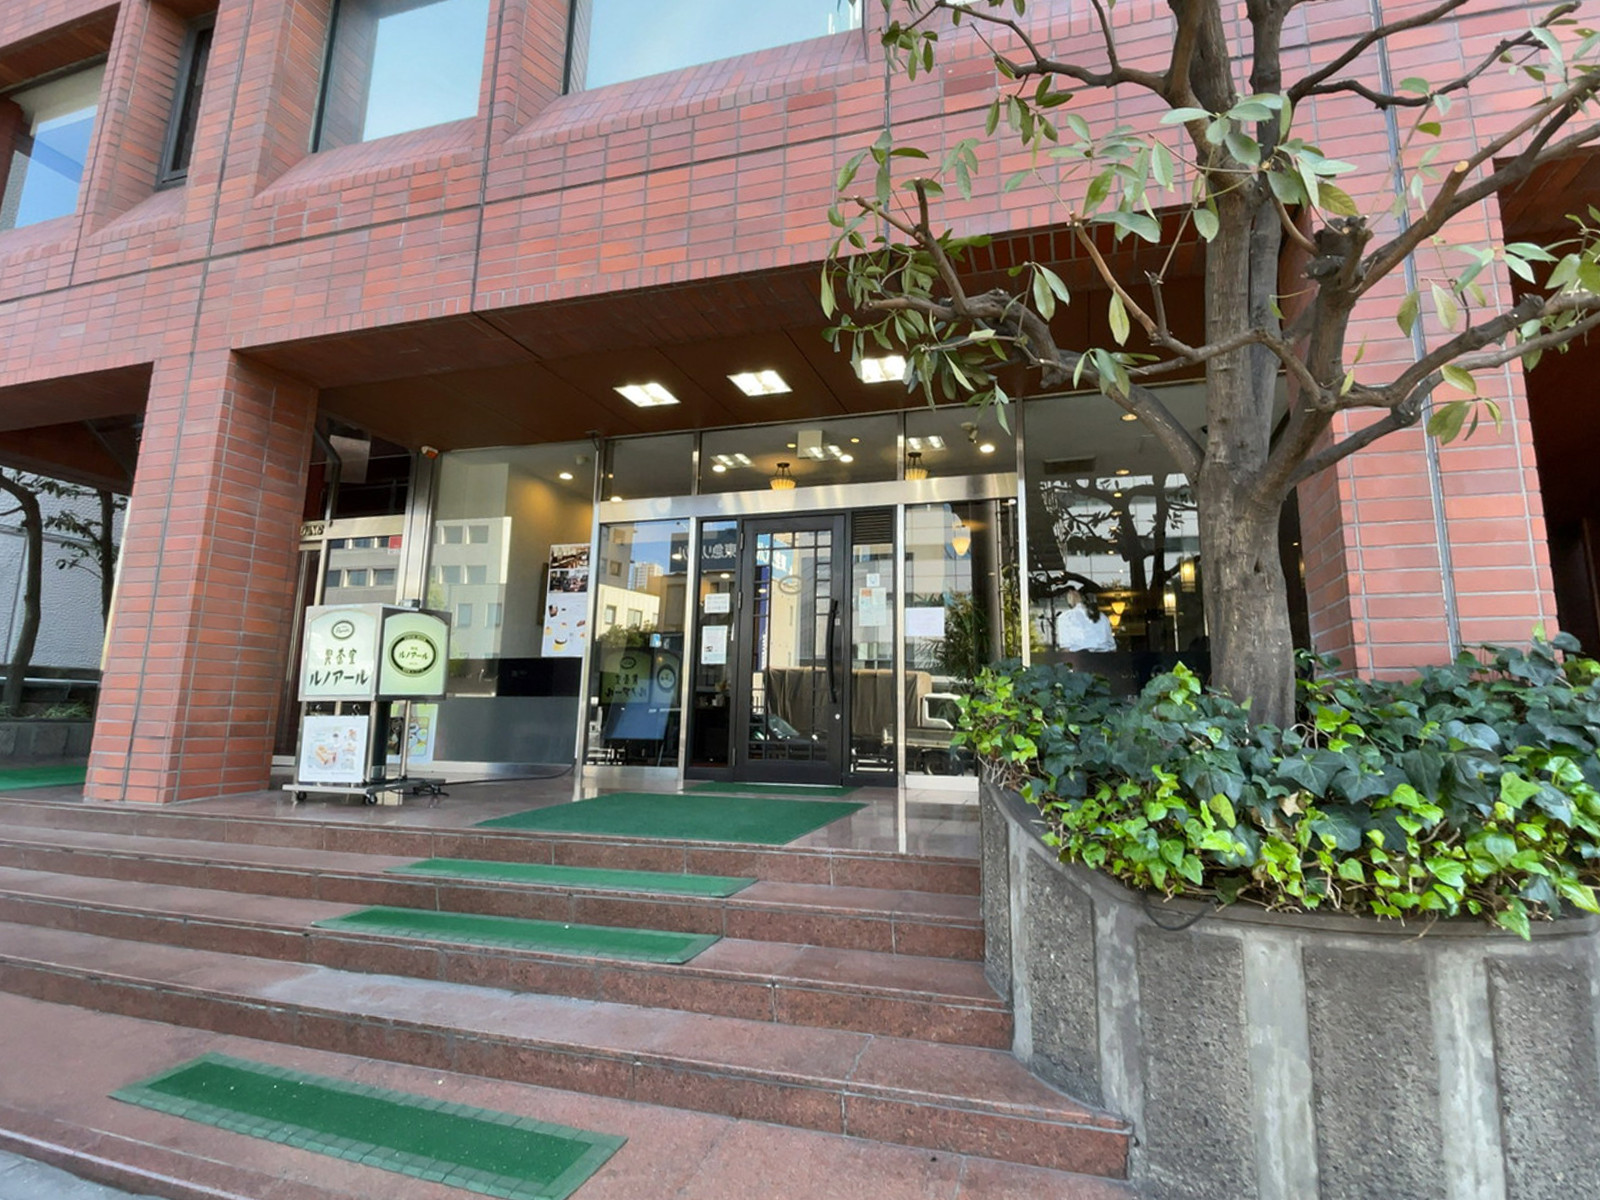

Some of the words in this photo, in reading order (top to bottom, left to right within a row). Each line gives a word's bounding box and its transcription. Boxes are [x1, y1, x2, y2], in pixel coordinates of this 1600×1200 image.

[398, 651, 428, 660] ルノアール
[309, 669, 369, 687] ルノアール
